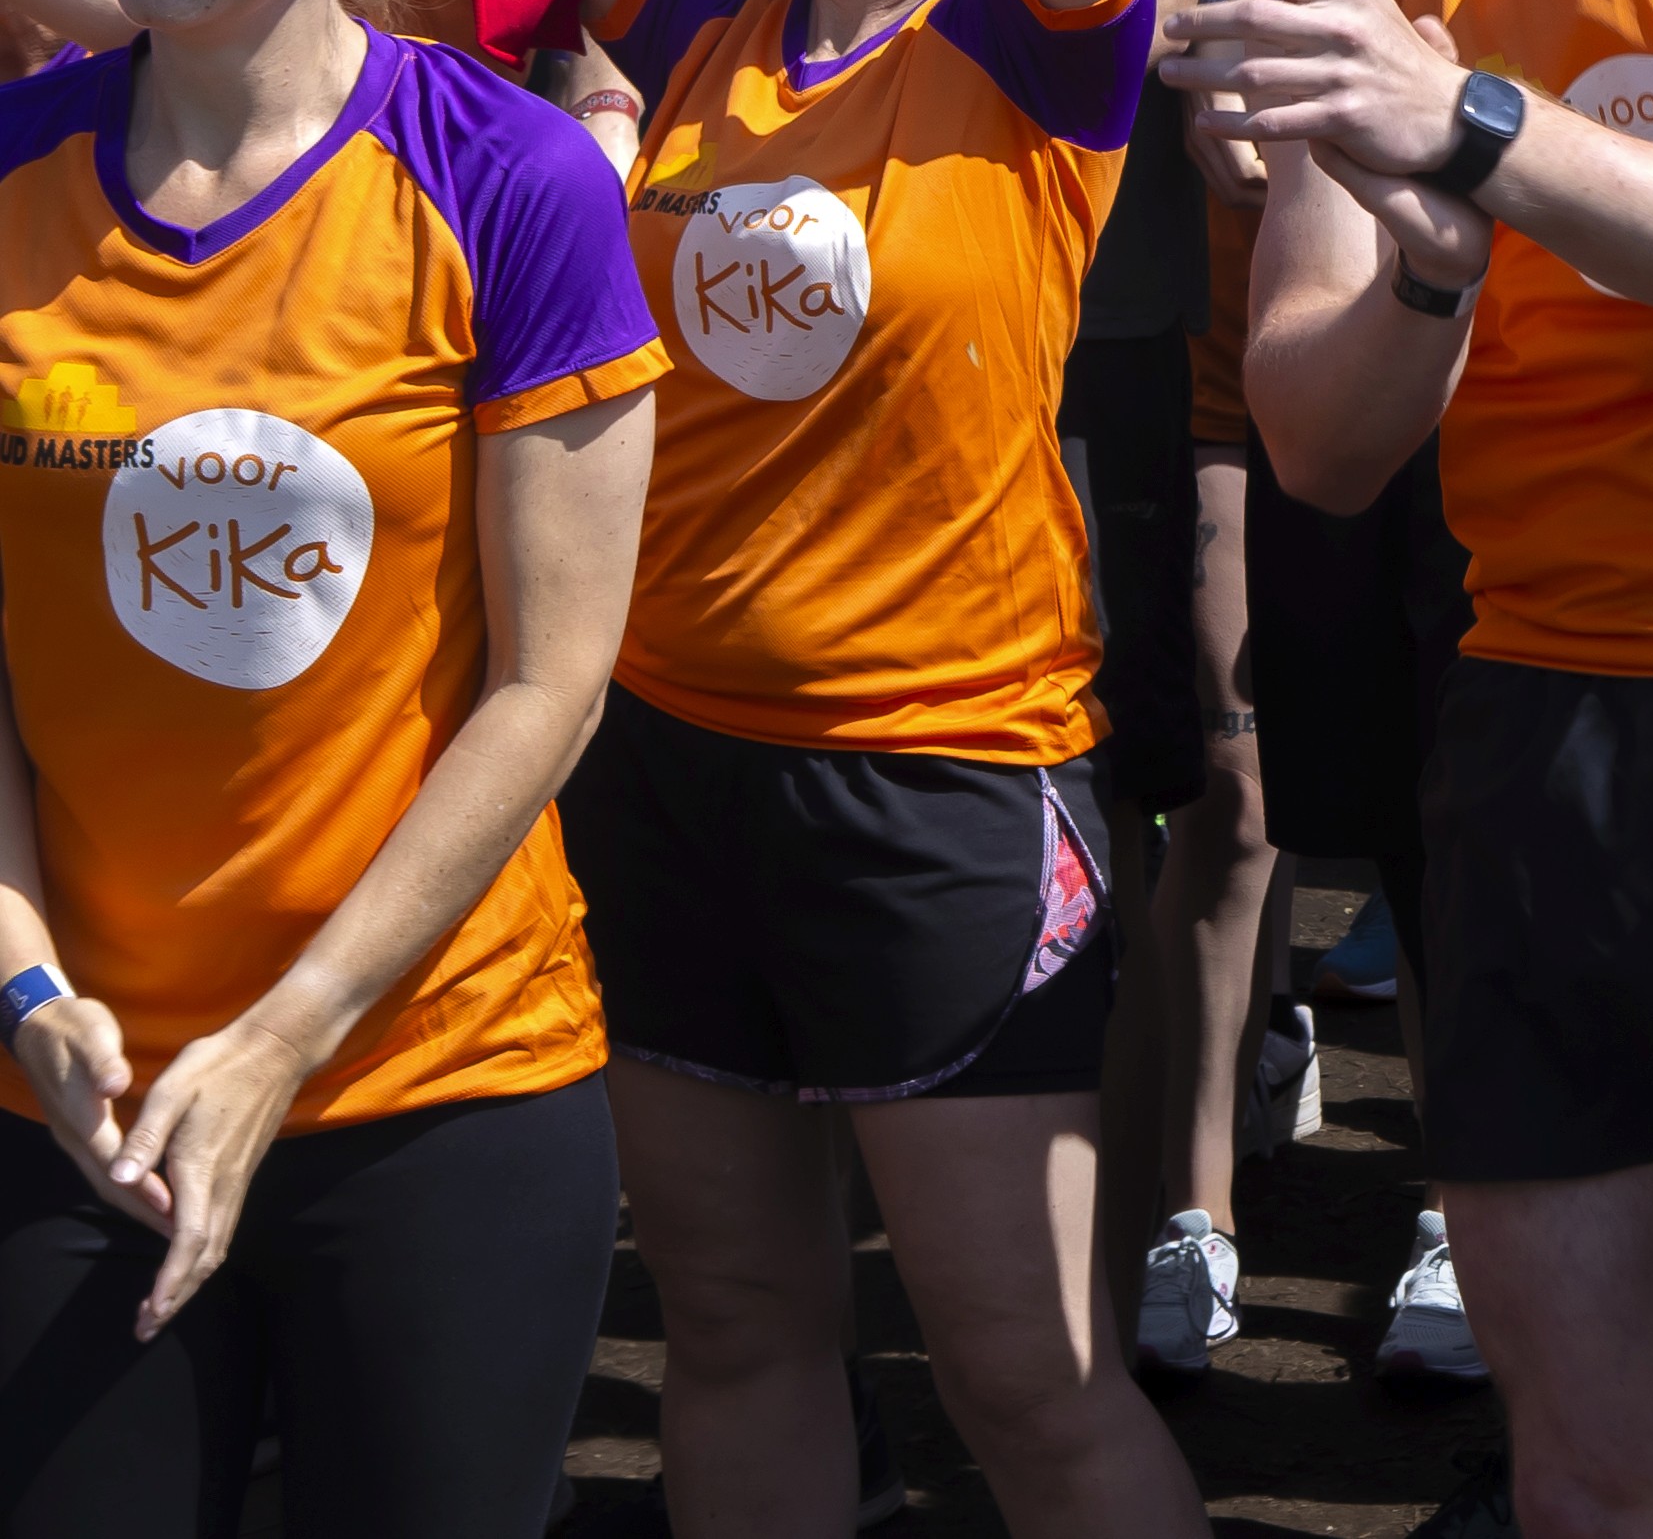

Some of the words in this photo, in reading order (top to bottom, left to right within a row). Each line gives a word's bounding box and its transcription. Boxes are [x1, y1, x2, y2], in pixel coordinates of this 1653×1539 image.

[717, 204, 819, 237] voor
[694, 250, 845, 335] KiKa
[0, 435, 27, 466] UD
[34, 437, 156, 470] MASTERS
[158, 451, 299, 492] voor
[133, 511, 344, 612] KiKa
